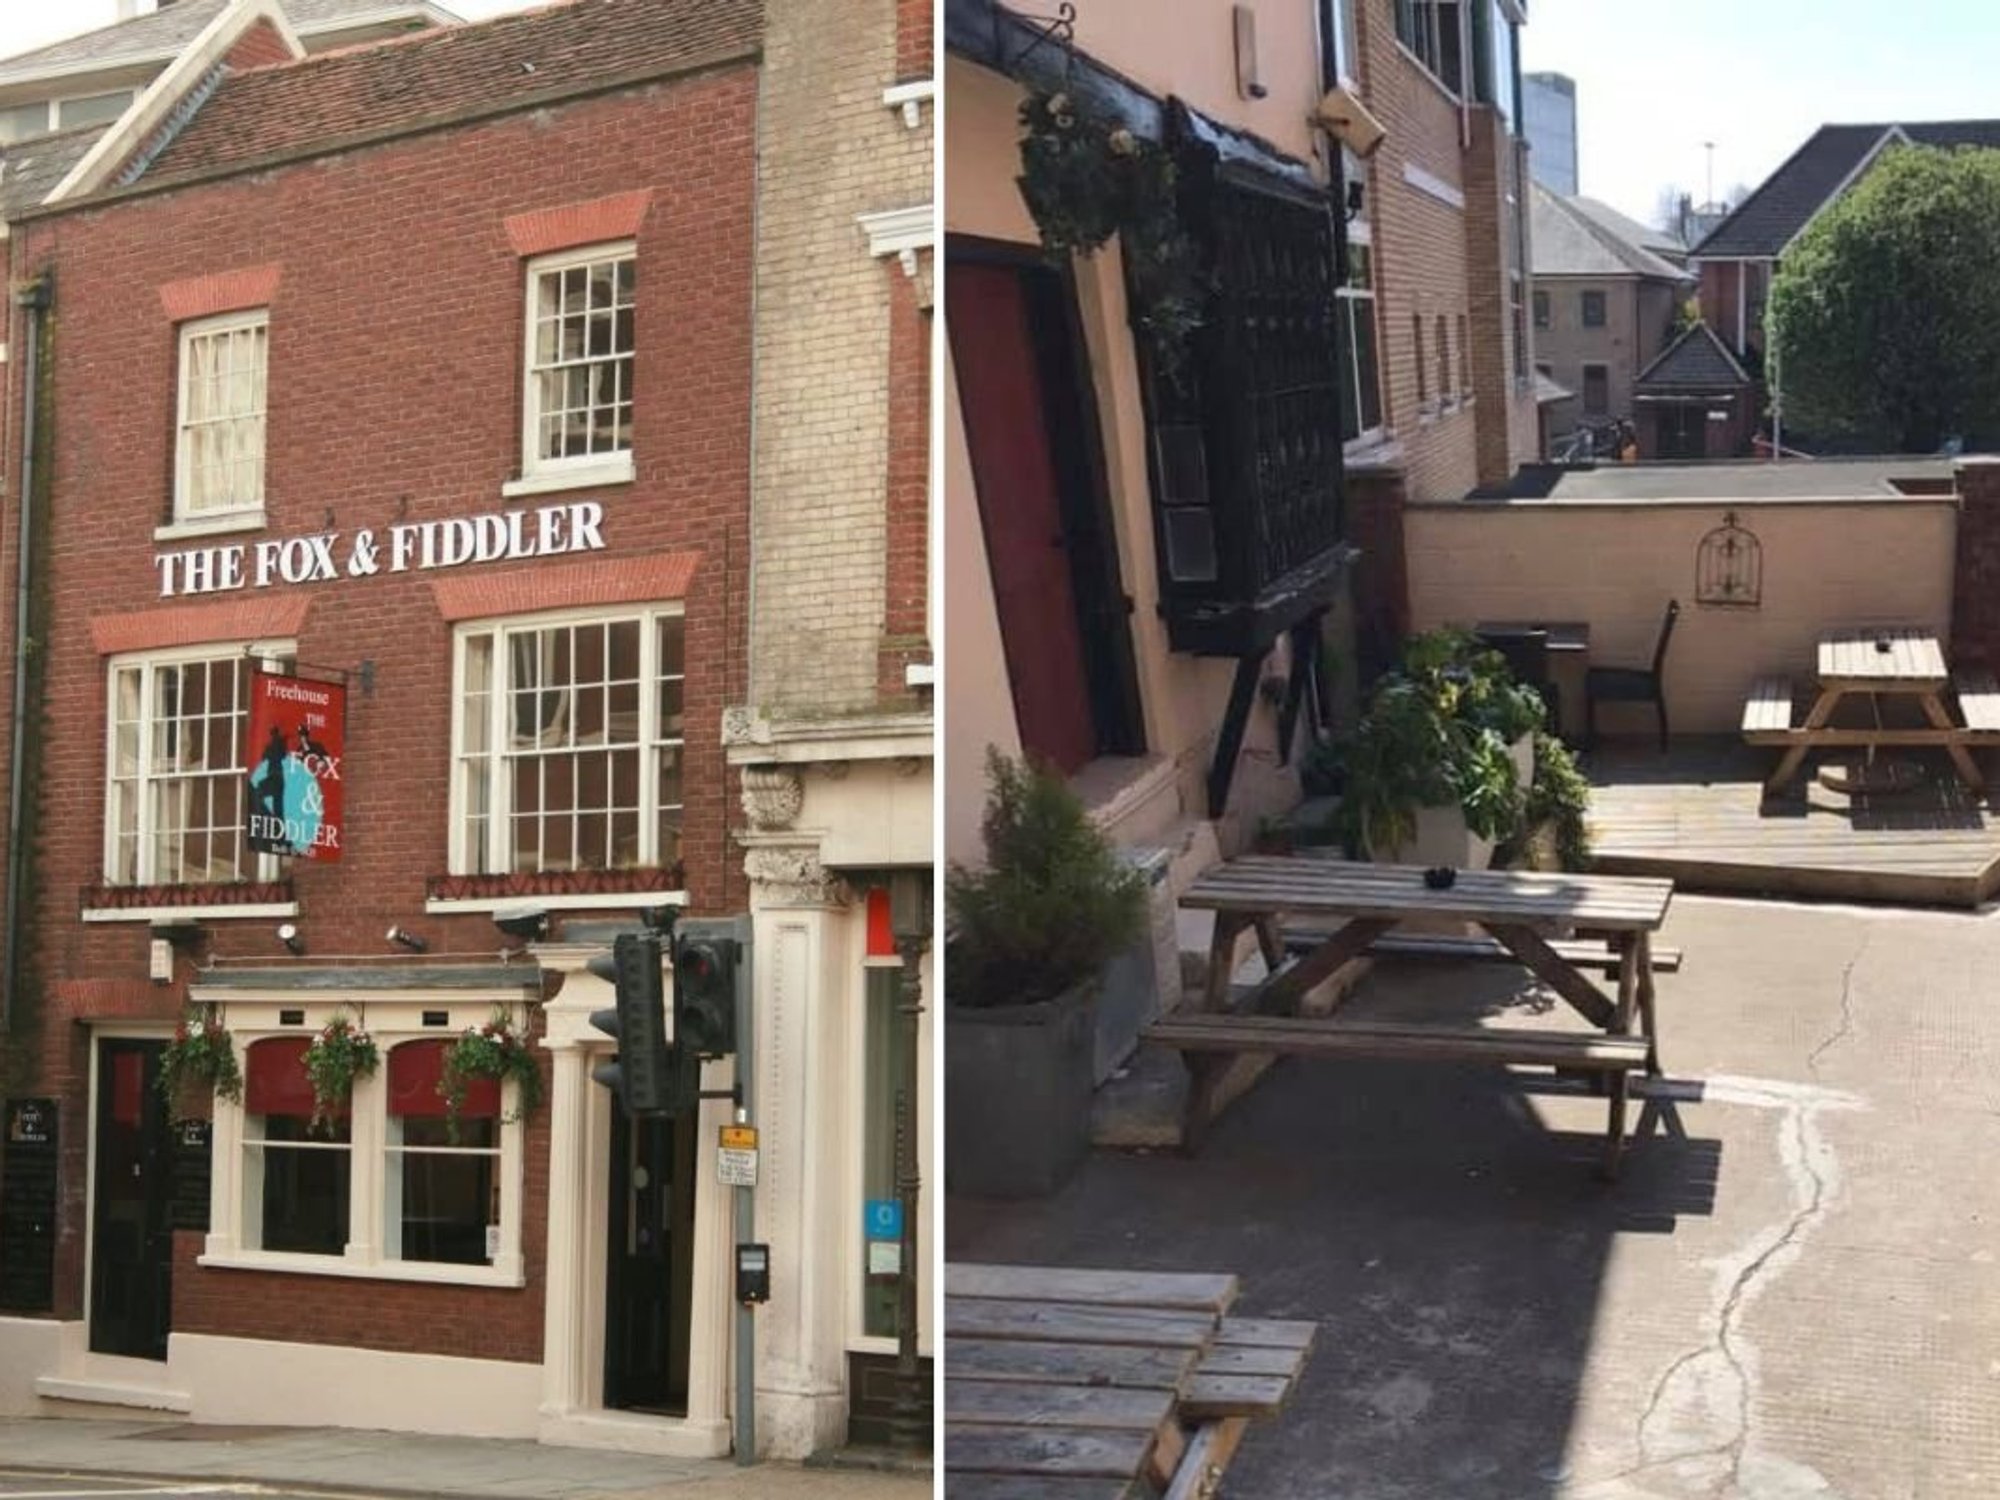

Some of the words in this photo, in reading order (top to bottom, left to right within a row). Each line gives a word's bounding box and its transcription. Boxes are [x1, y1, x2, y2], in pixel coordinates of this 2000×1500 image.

[155, 544, 245, 597] THE
[254, 532, 340, 587] FOX
[348, 528, 380, 577] &
[388, 501, 606, 572] FIDDLER
[266, 680, 330, 705] Freehouse
[306, 713, 326, 728] THE
[290, 751, 341, 780] FOX
[301, 781, 325, 817] &
[250, 814, 340, 848] FIDDLER
